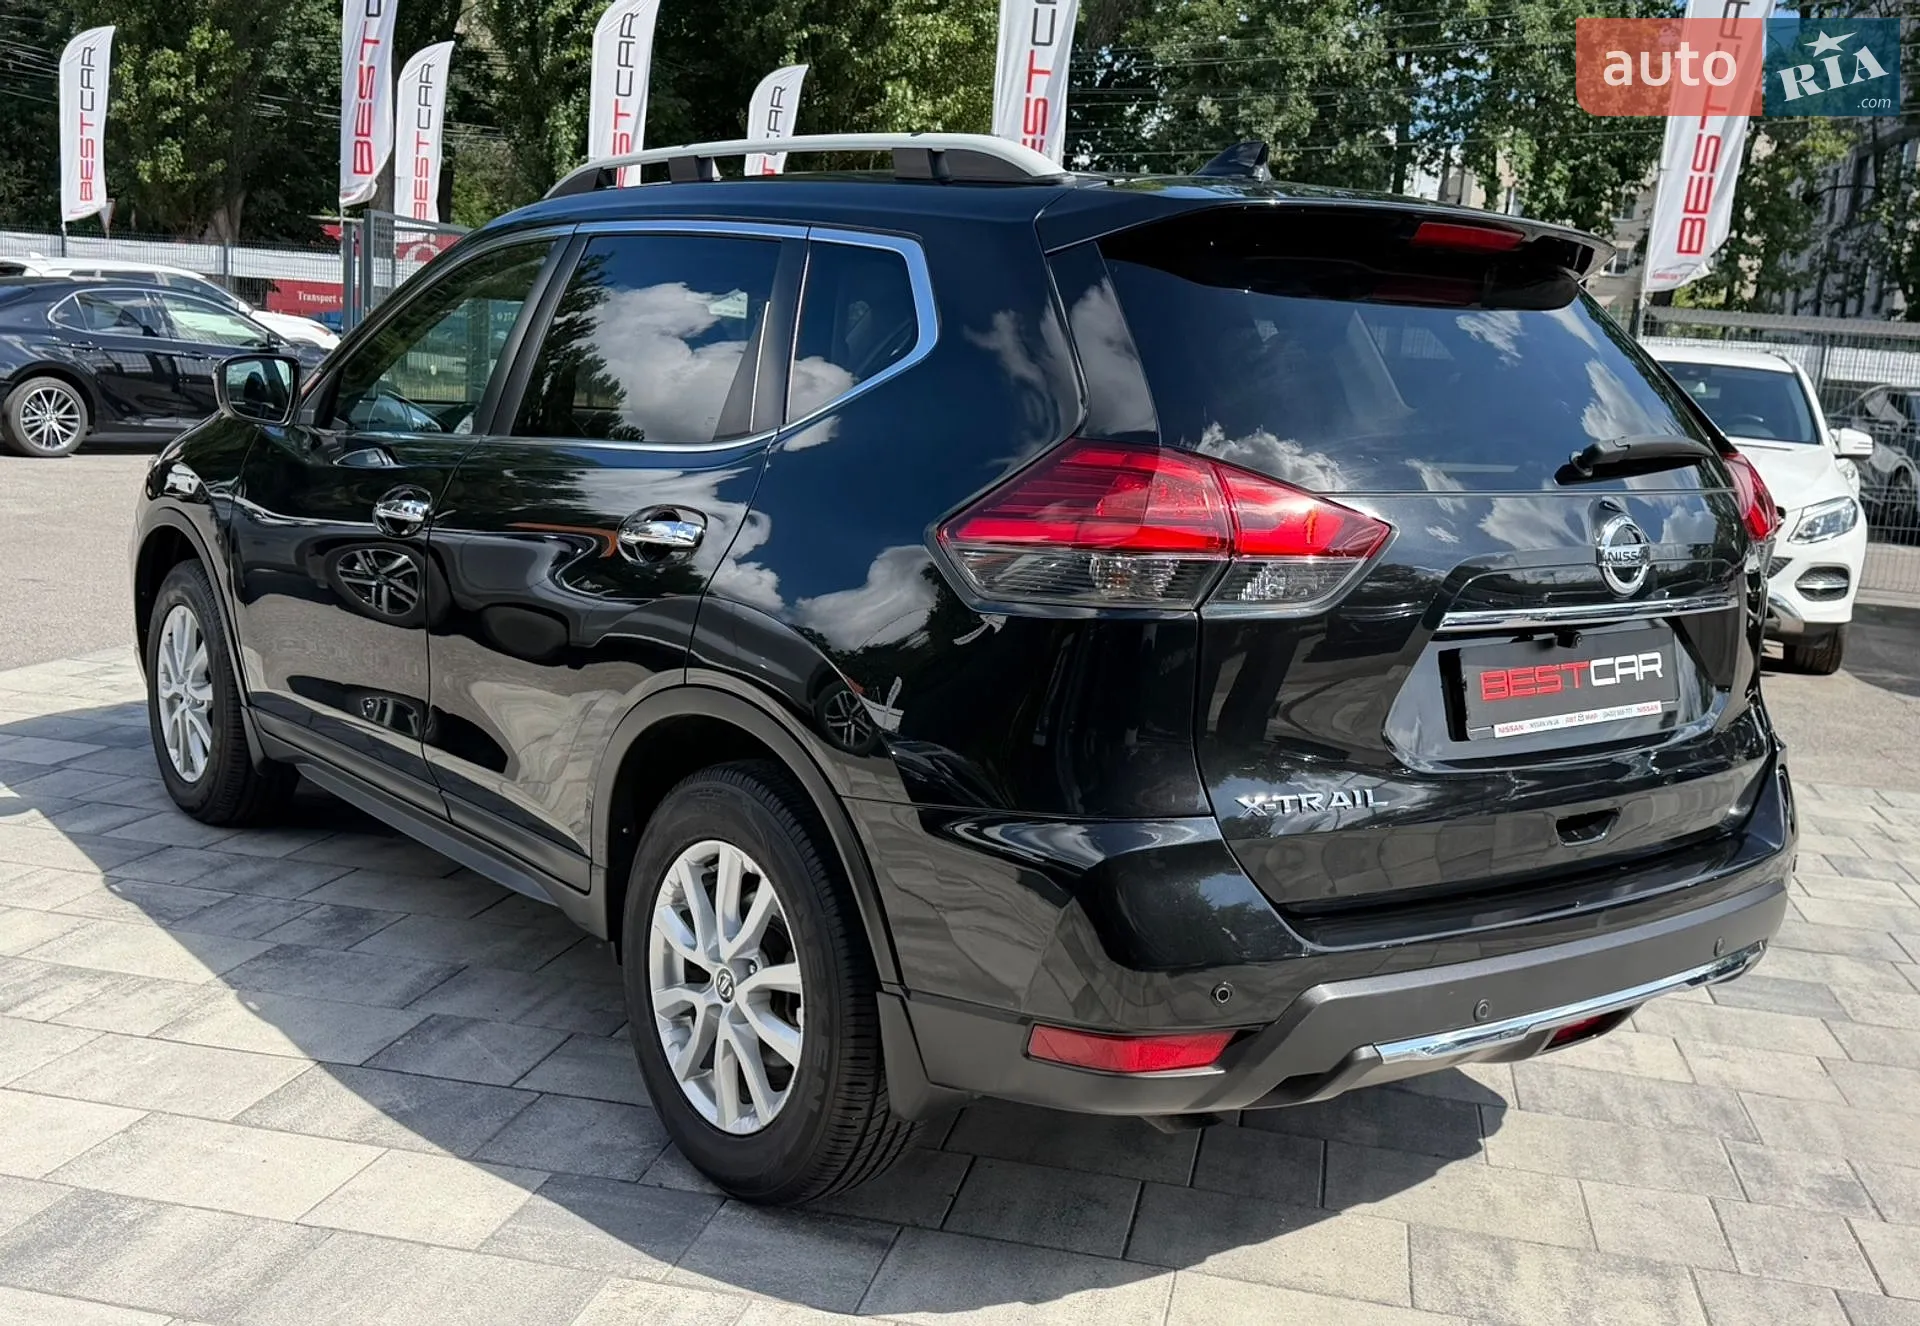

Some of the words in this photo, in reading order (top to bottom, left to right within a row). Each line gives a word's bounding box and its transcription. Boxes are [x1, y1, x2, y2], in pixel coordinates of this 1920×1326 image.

[80, 46, 96, 201] BESTCAR
[413, 62, 435, 221] BESTCAR
[297, 291, 337, 304] Transport
[1607, 550, 1644, 563] NISS
[1480, 651, 1664, 701] BESTCAR
[1234, 788, 1390, 818] X-TRAIL
